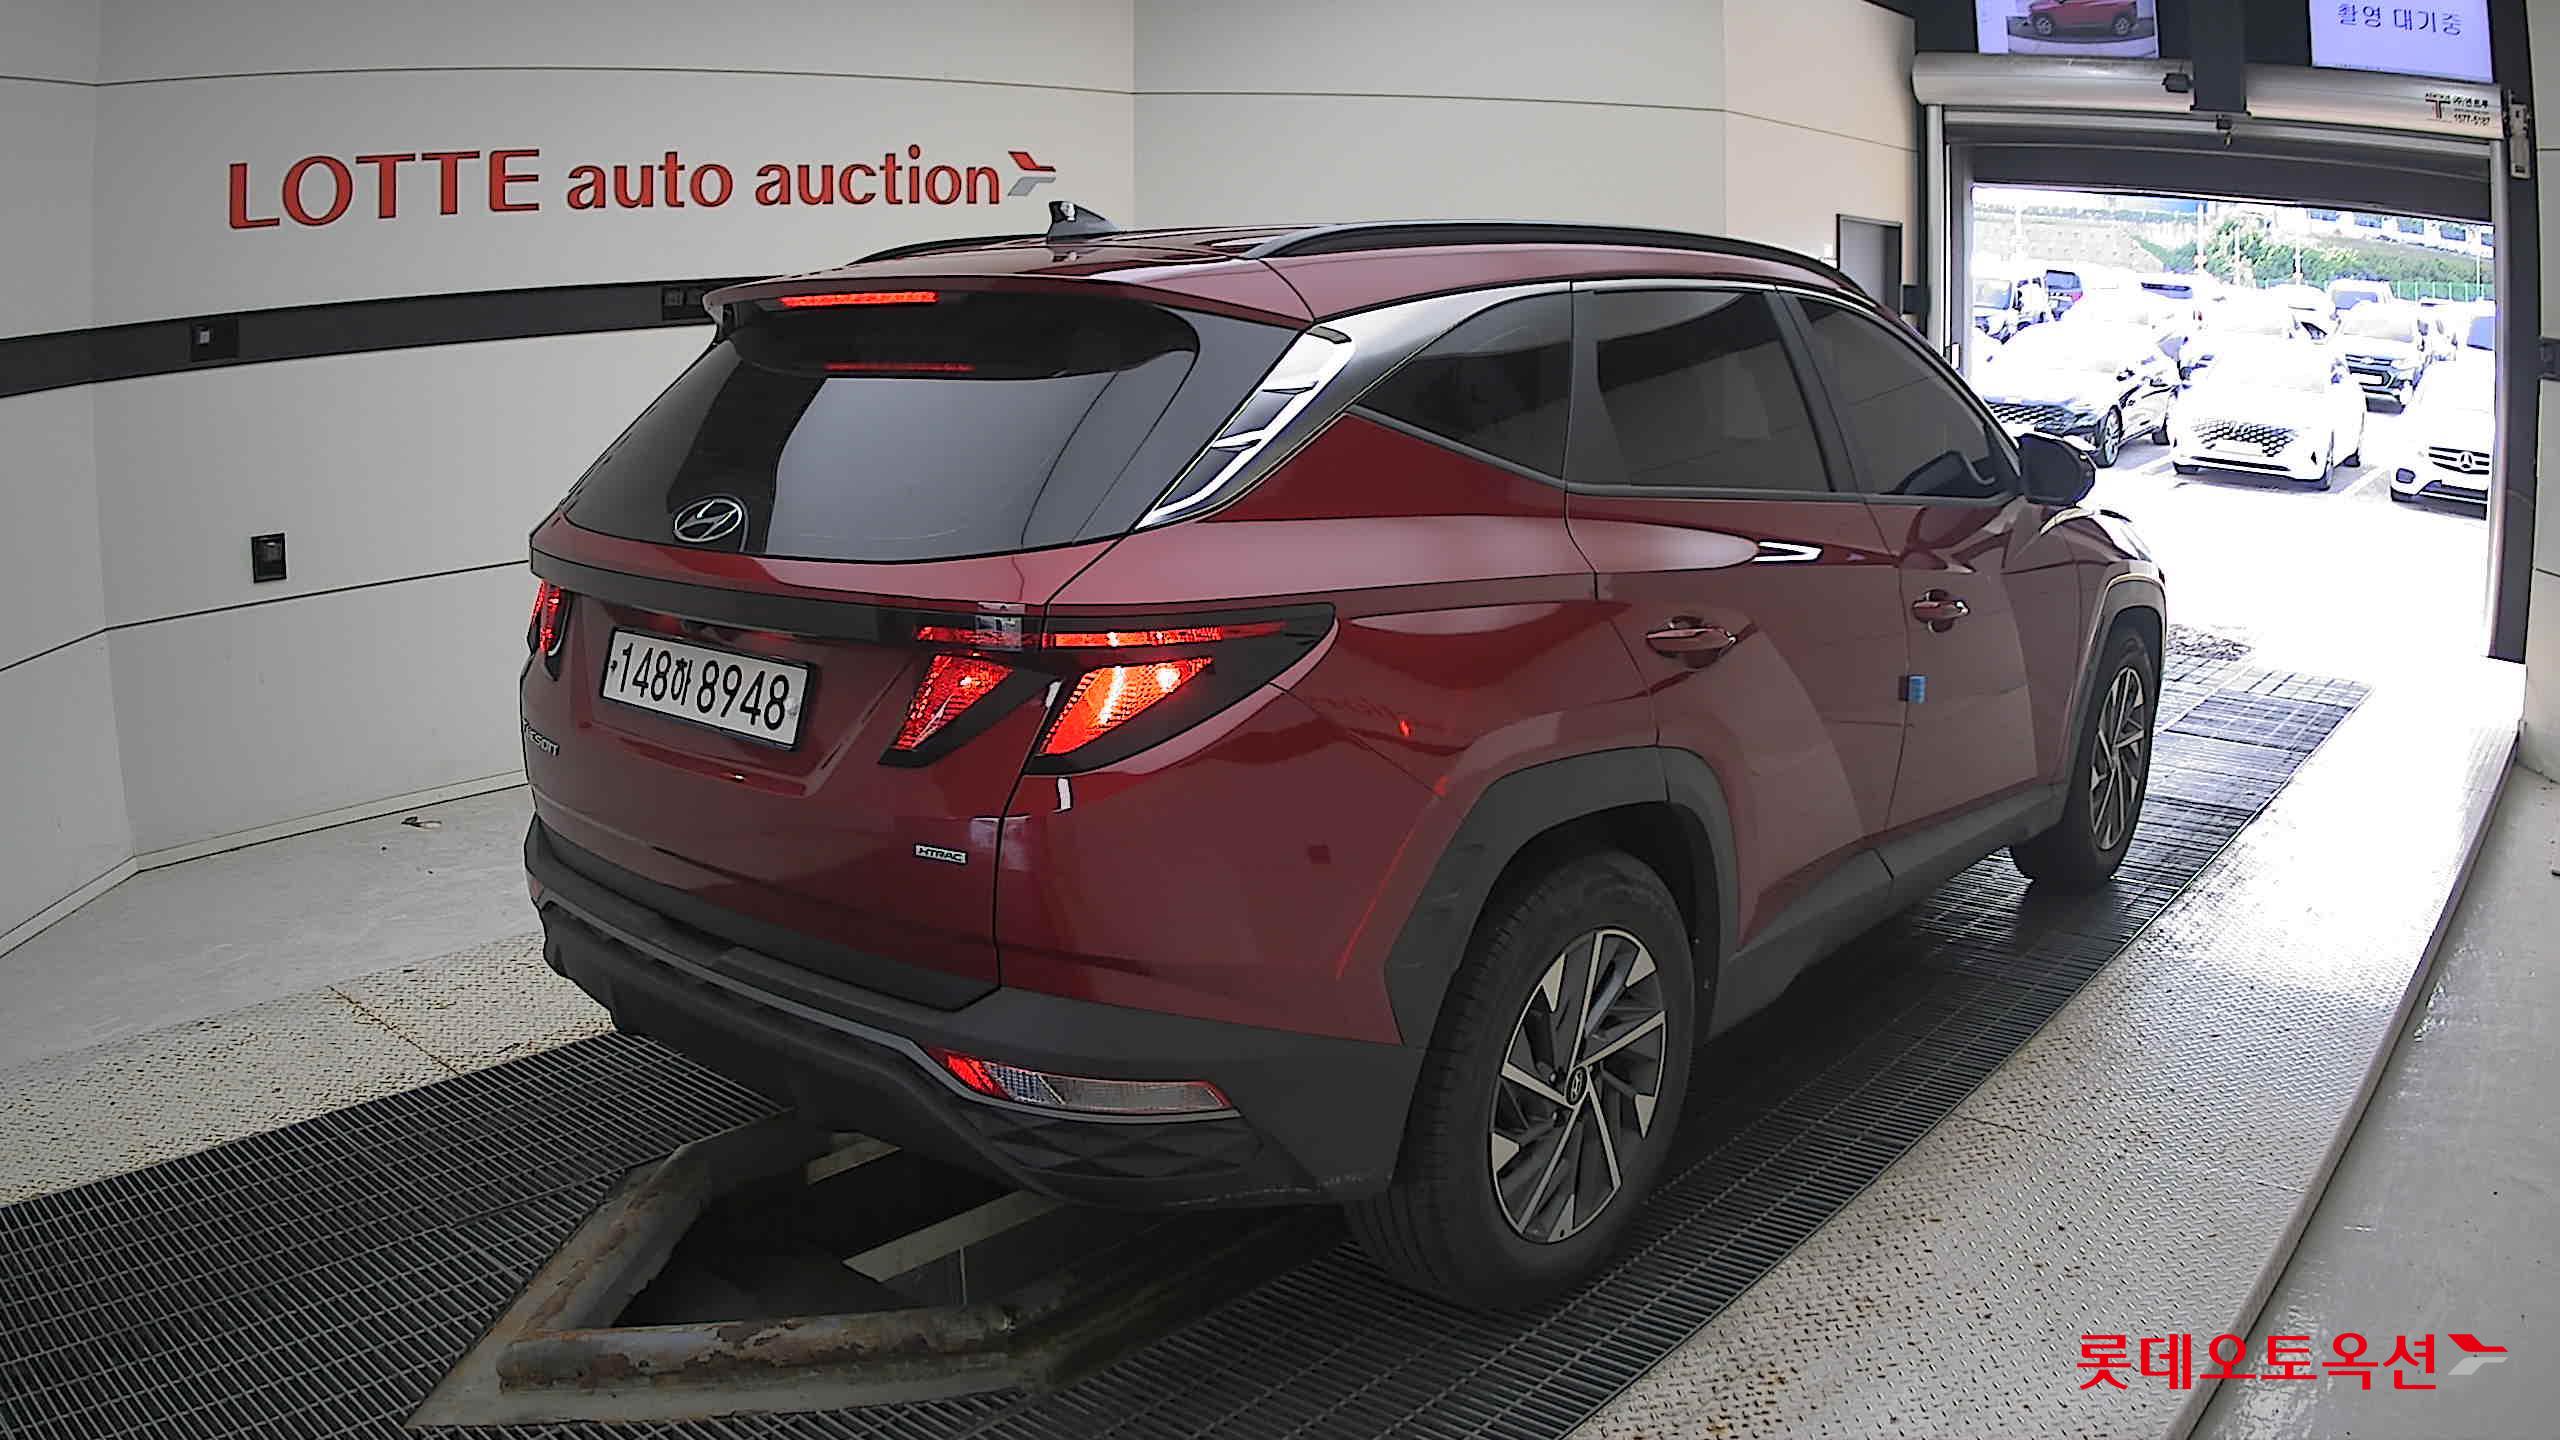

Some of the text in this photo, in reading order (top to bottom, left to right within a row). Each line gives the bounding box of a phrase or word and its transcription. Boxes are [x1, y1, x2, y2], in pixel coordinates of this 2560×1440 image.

[2393, 9, 2461, 36] 대기중
[229, 145, 1000, 231] LOTTE auto auction
[620, 643, 790, 730] 148하 8948
[919, 847, 964, 862] HTRAC
